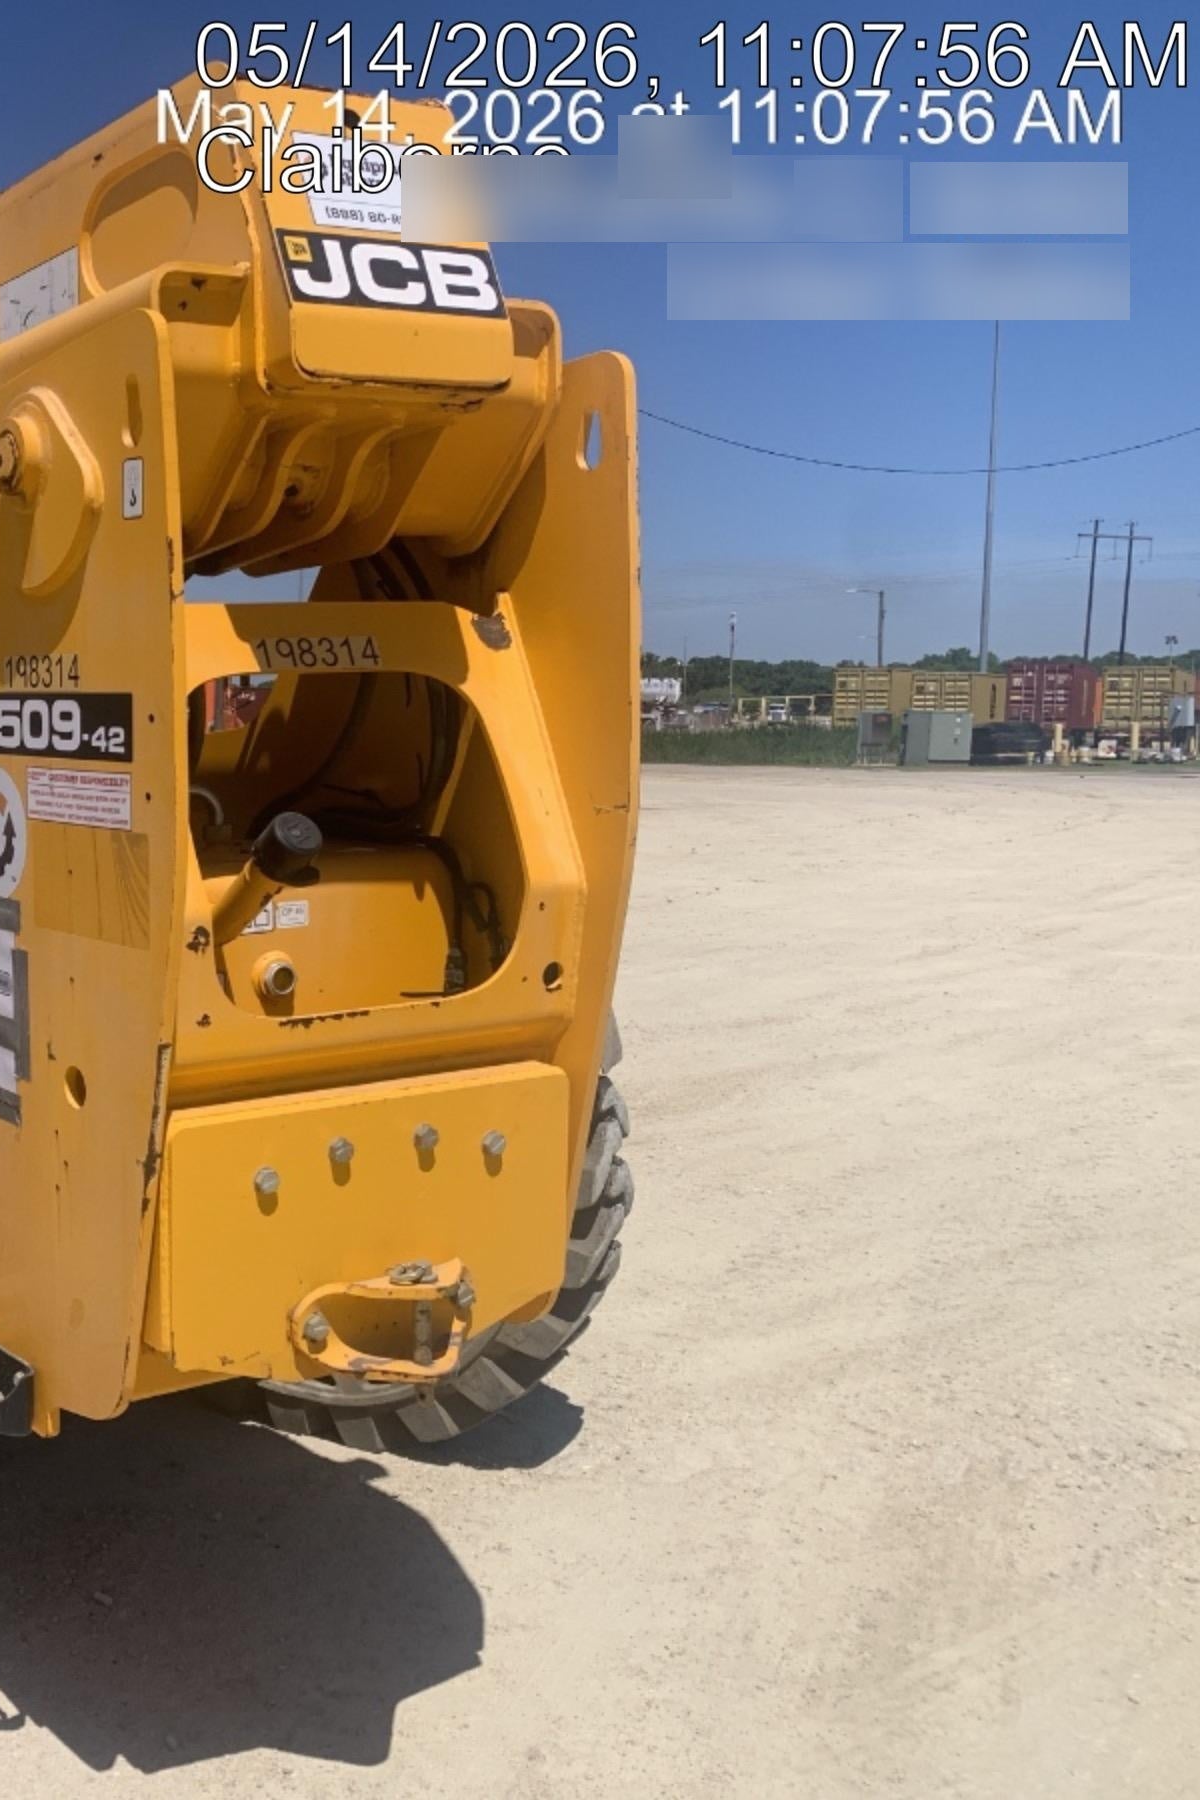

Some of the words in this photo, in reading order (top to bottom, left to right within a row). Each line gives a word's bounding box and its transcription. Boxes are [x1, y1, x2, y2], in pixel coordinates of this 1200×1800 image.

[292, 239, 499, 311] JCB
[256, 635, 380, 669] 198314
[5, 653, 81, 689] 198314
